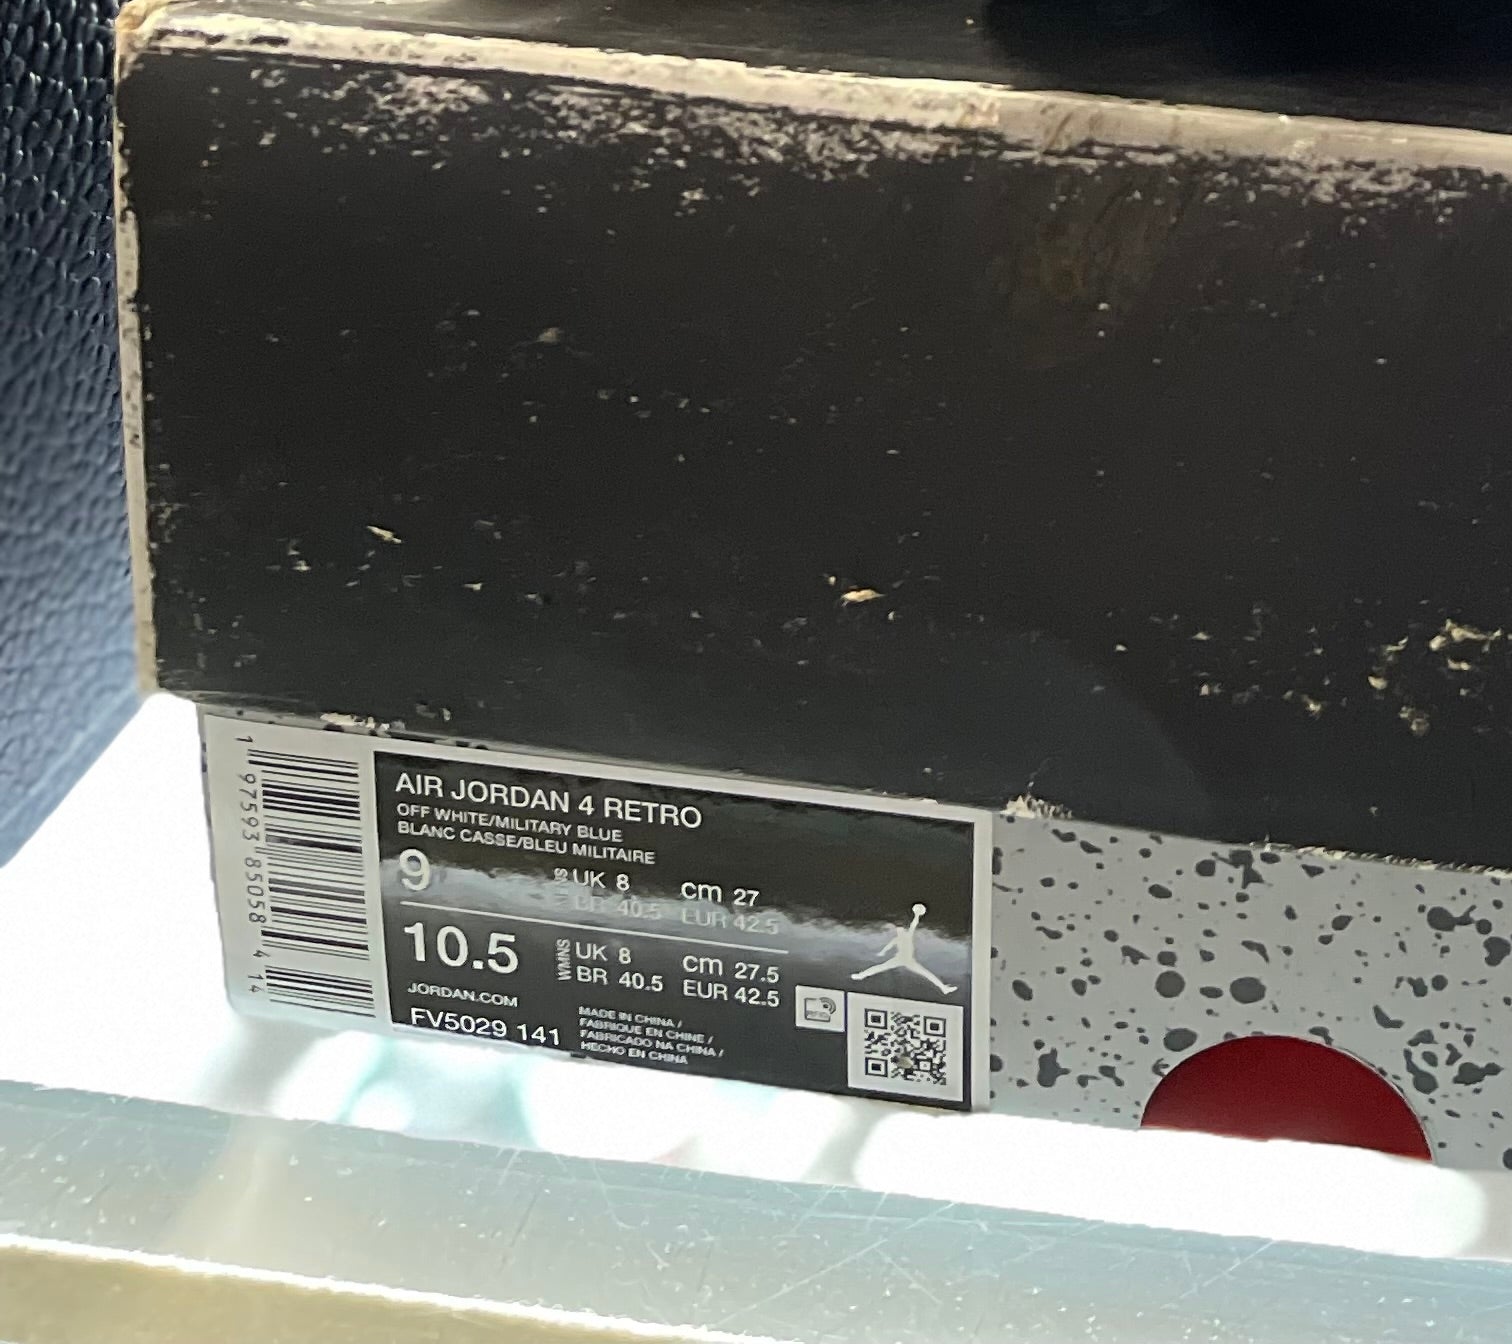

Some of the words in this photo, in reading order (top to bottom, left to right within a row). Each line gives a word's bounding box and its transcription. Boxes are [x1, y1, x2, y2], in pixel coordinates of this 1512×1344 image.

[239, 772, 261, 842] 97593
[395, 773, 443, 797] AIR
[450, 779, 569, 813] JORDAN
[579, 795, 594, 816] 4
[604, 797, 701, 828] RETRO
[396, 803, 430, 818] OFF
[434, 807, 572, 836] WHITE/MILITARY
[577, 825, 623, 843] BLUE
[398, 821, 455, 840] BLANC
[460, 828, 567, 854] CASSE/BLEU
[572, 842, 656, 864] MILITAIRE
[399, 848, 431, 891] 9
[573, 868, 606, 889] UK
[616, 873, 630, 891] 8
[681, 881, 722, 903] cm
[733, 888, 760, 907] 27
[243, 857, 267, 924] 85058
[681, 907, 727, 929] EUR
[733, 913, 780, 935] 42.5
[404, 922, 519, 974] 10.5
[556, 938, 572, 981] WMNS
[575, 941, 608, 962] UK
[618, 947, 632, 965] 8
[682, 955, 723, 976] cm
[734, 962, 780, 984] 27.5
[407, 982, 518, 1008] JORDAN.COM
[576, 965, 608, 985] BR
[618, 972, 664, 992] 40.5
[683, 979, 728, 1001] EUR
[734, 987, 780, 1008] 42.5
[410, 1007, 507, 1038] FV5029
[517, 1023, 560, 1046] 141
[578, 1006, 616, 1020] MADE
[619, 1012, 632, 1022] IN
[634, 1014, 675, 1028] CHINA
[579, 1017, 642, 1035] FABRIQUE
[645, 1027, 663, 1038] EN
[665, 1030, 705, 1044] CHINE
[579, 1029, 653, 1048] FABRICADO
[655, 1039, 674, 1051] NA
[676, 1043, 717, 1057] CHINA
[580, 1041, 627, 1055] HECHO
[628, 1047, 646, 1059] EN
[648, 1050, 688, 1065] CHINA
